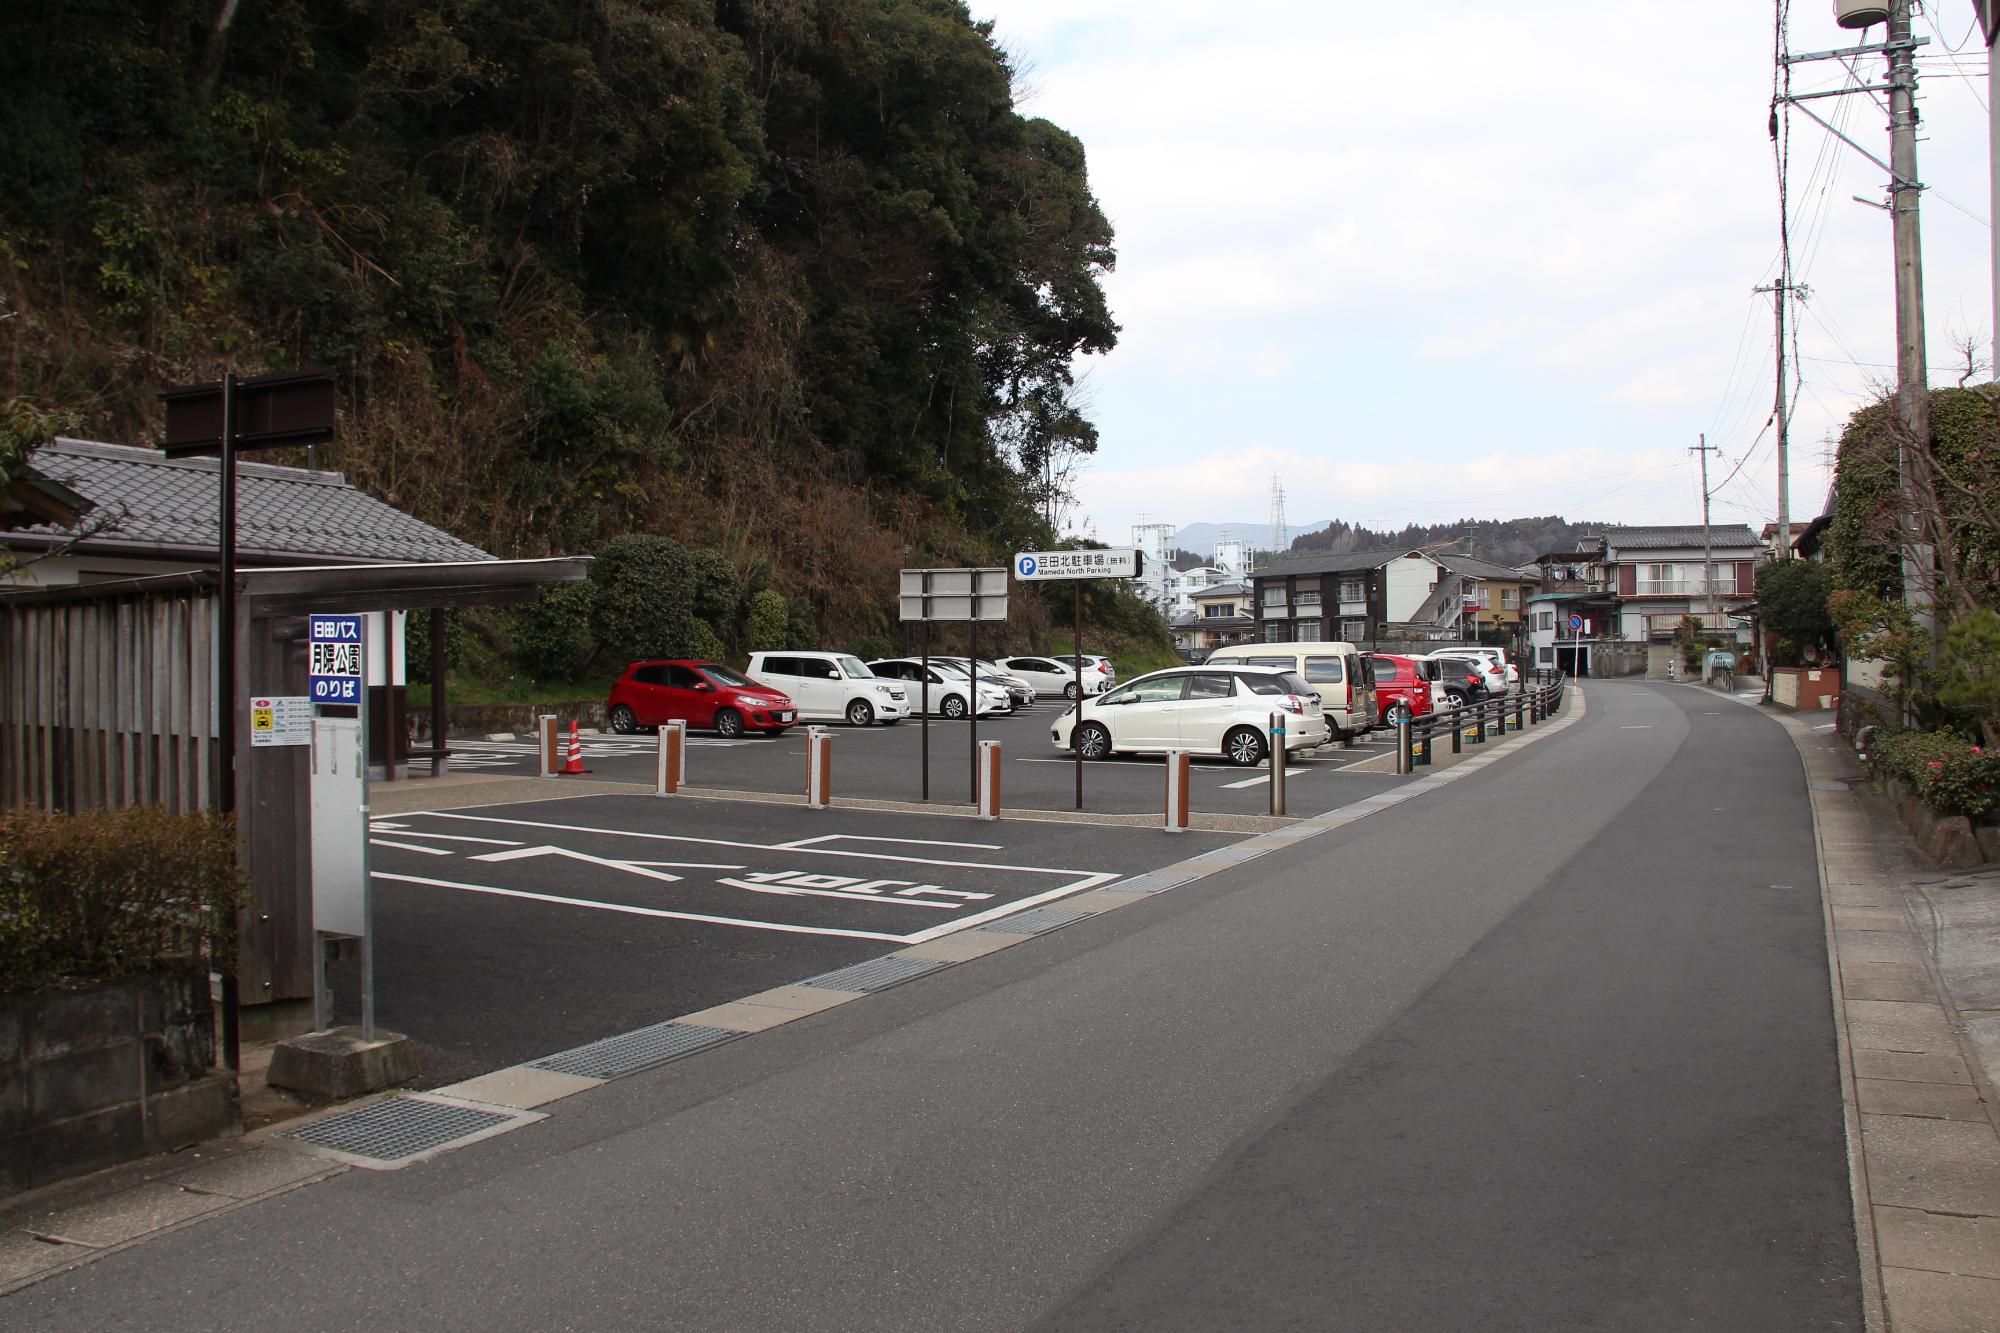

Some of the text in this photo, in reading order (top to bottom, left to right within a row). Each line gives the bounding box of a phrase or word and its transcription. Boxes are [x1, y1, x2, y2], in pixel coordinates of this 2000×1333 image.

[1023, 559, 1031, 573] P
[314, 621, 357, 639] 日田バス
[312, 644, 360, 675] 月隈公園
[316, 681, 355, 698] のりば
